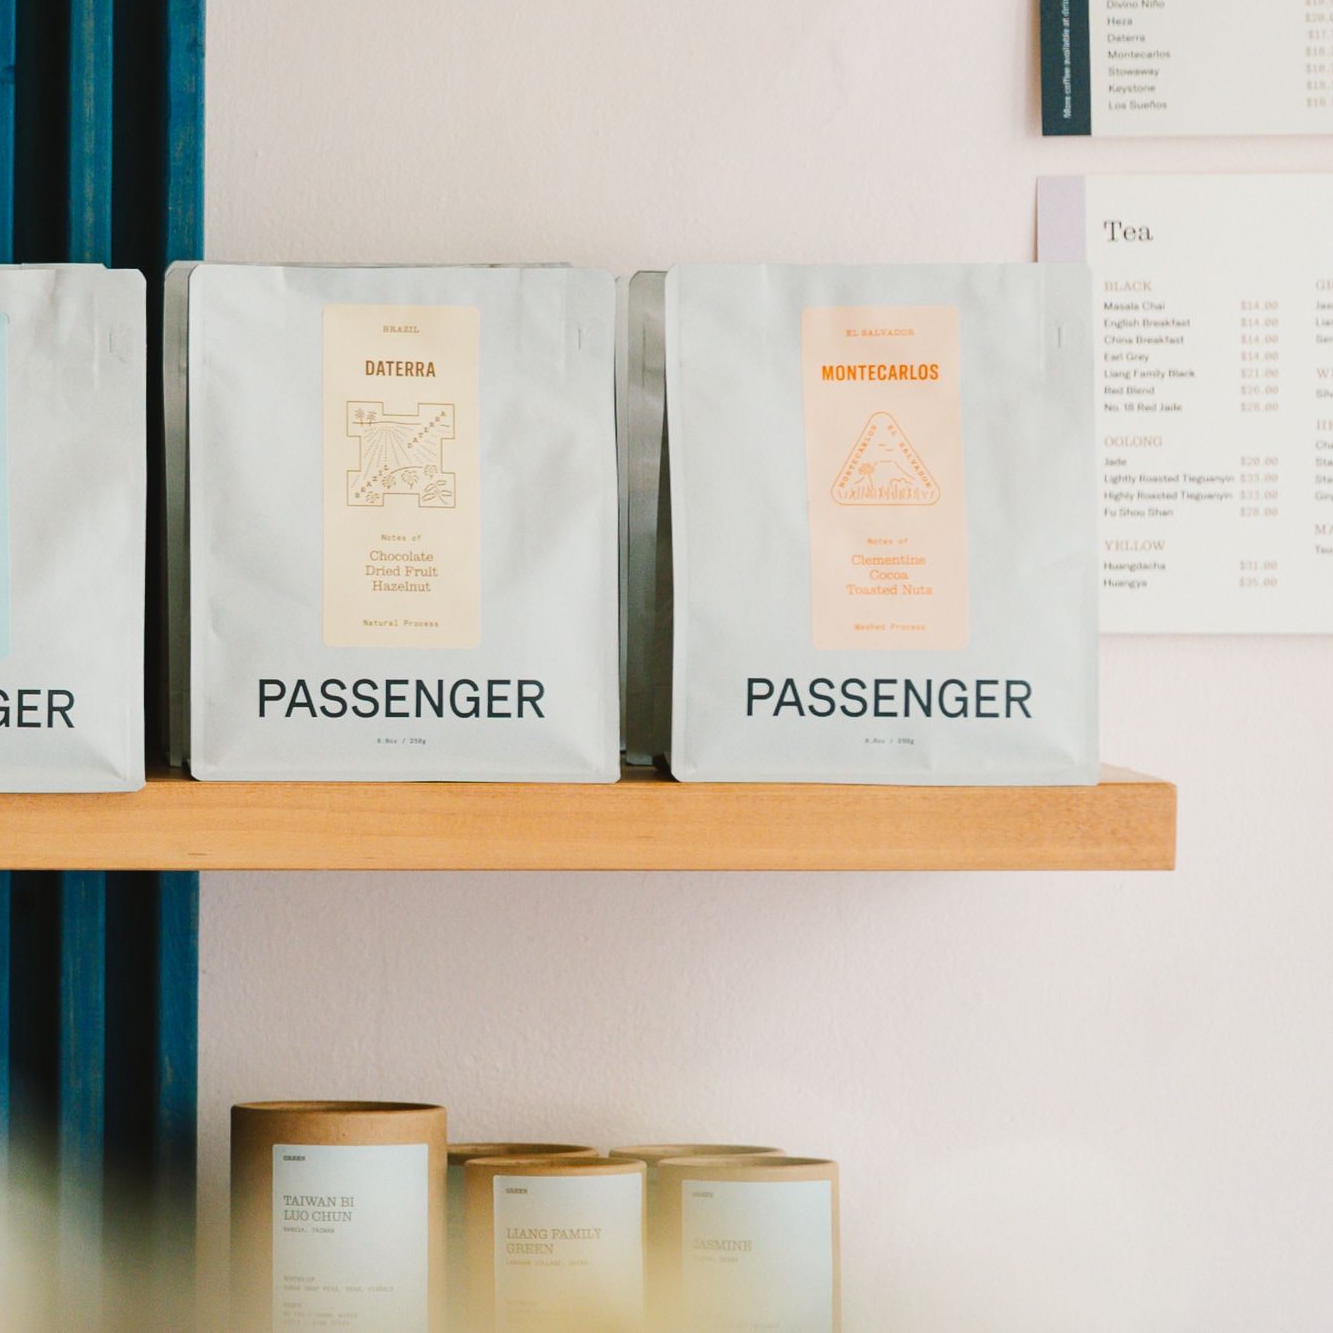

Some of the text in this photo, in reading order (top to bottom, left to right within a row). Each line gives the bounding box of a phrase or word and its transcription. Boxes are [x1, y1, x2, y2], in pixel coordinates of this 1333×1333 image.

[1106, 0, 1165, 9] Divino Niño
[1107, 50, 1171, 60] Montecarlos
[1108, 67, 1159, 77] Stowaway
[1108, 84, 1156, 95] Keystone
[1103, 220, 1153, 242] Tea
[1104, 281, 1152, 292] BLACK
[382, 325, 420, 334] BRAZIL
[365, 359, 436, 378] DATERRA
[821, 363, 939, 382] MONTECARLOS
[1103, 435, 1163, 447] OOLONG
[369, 549, 434, 563] Chocolate
[851, 554, 926, 566] Clementine
[364, 564, 438, 578] Dried Fruit
[868, 569, 909, 581] Cocoa
[372, 579, 431, 593] Hazelnut
[846, 583, 933, 596] Toasted Nuts
[258, 678, 545, 719] PASSENGER
[746, 677, 1032, 719] PASSENGER
[282, 1194, 356, 1208] TAIWAN BI
[283, 1209, 310, 1222] LUO
[506, 1227, 604, 1241] LIANG FAMILY
[506, 1242, 555, 1255] GREEN
